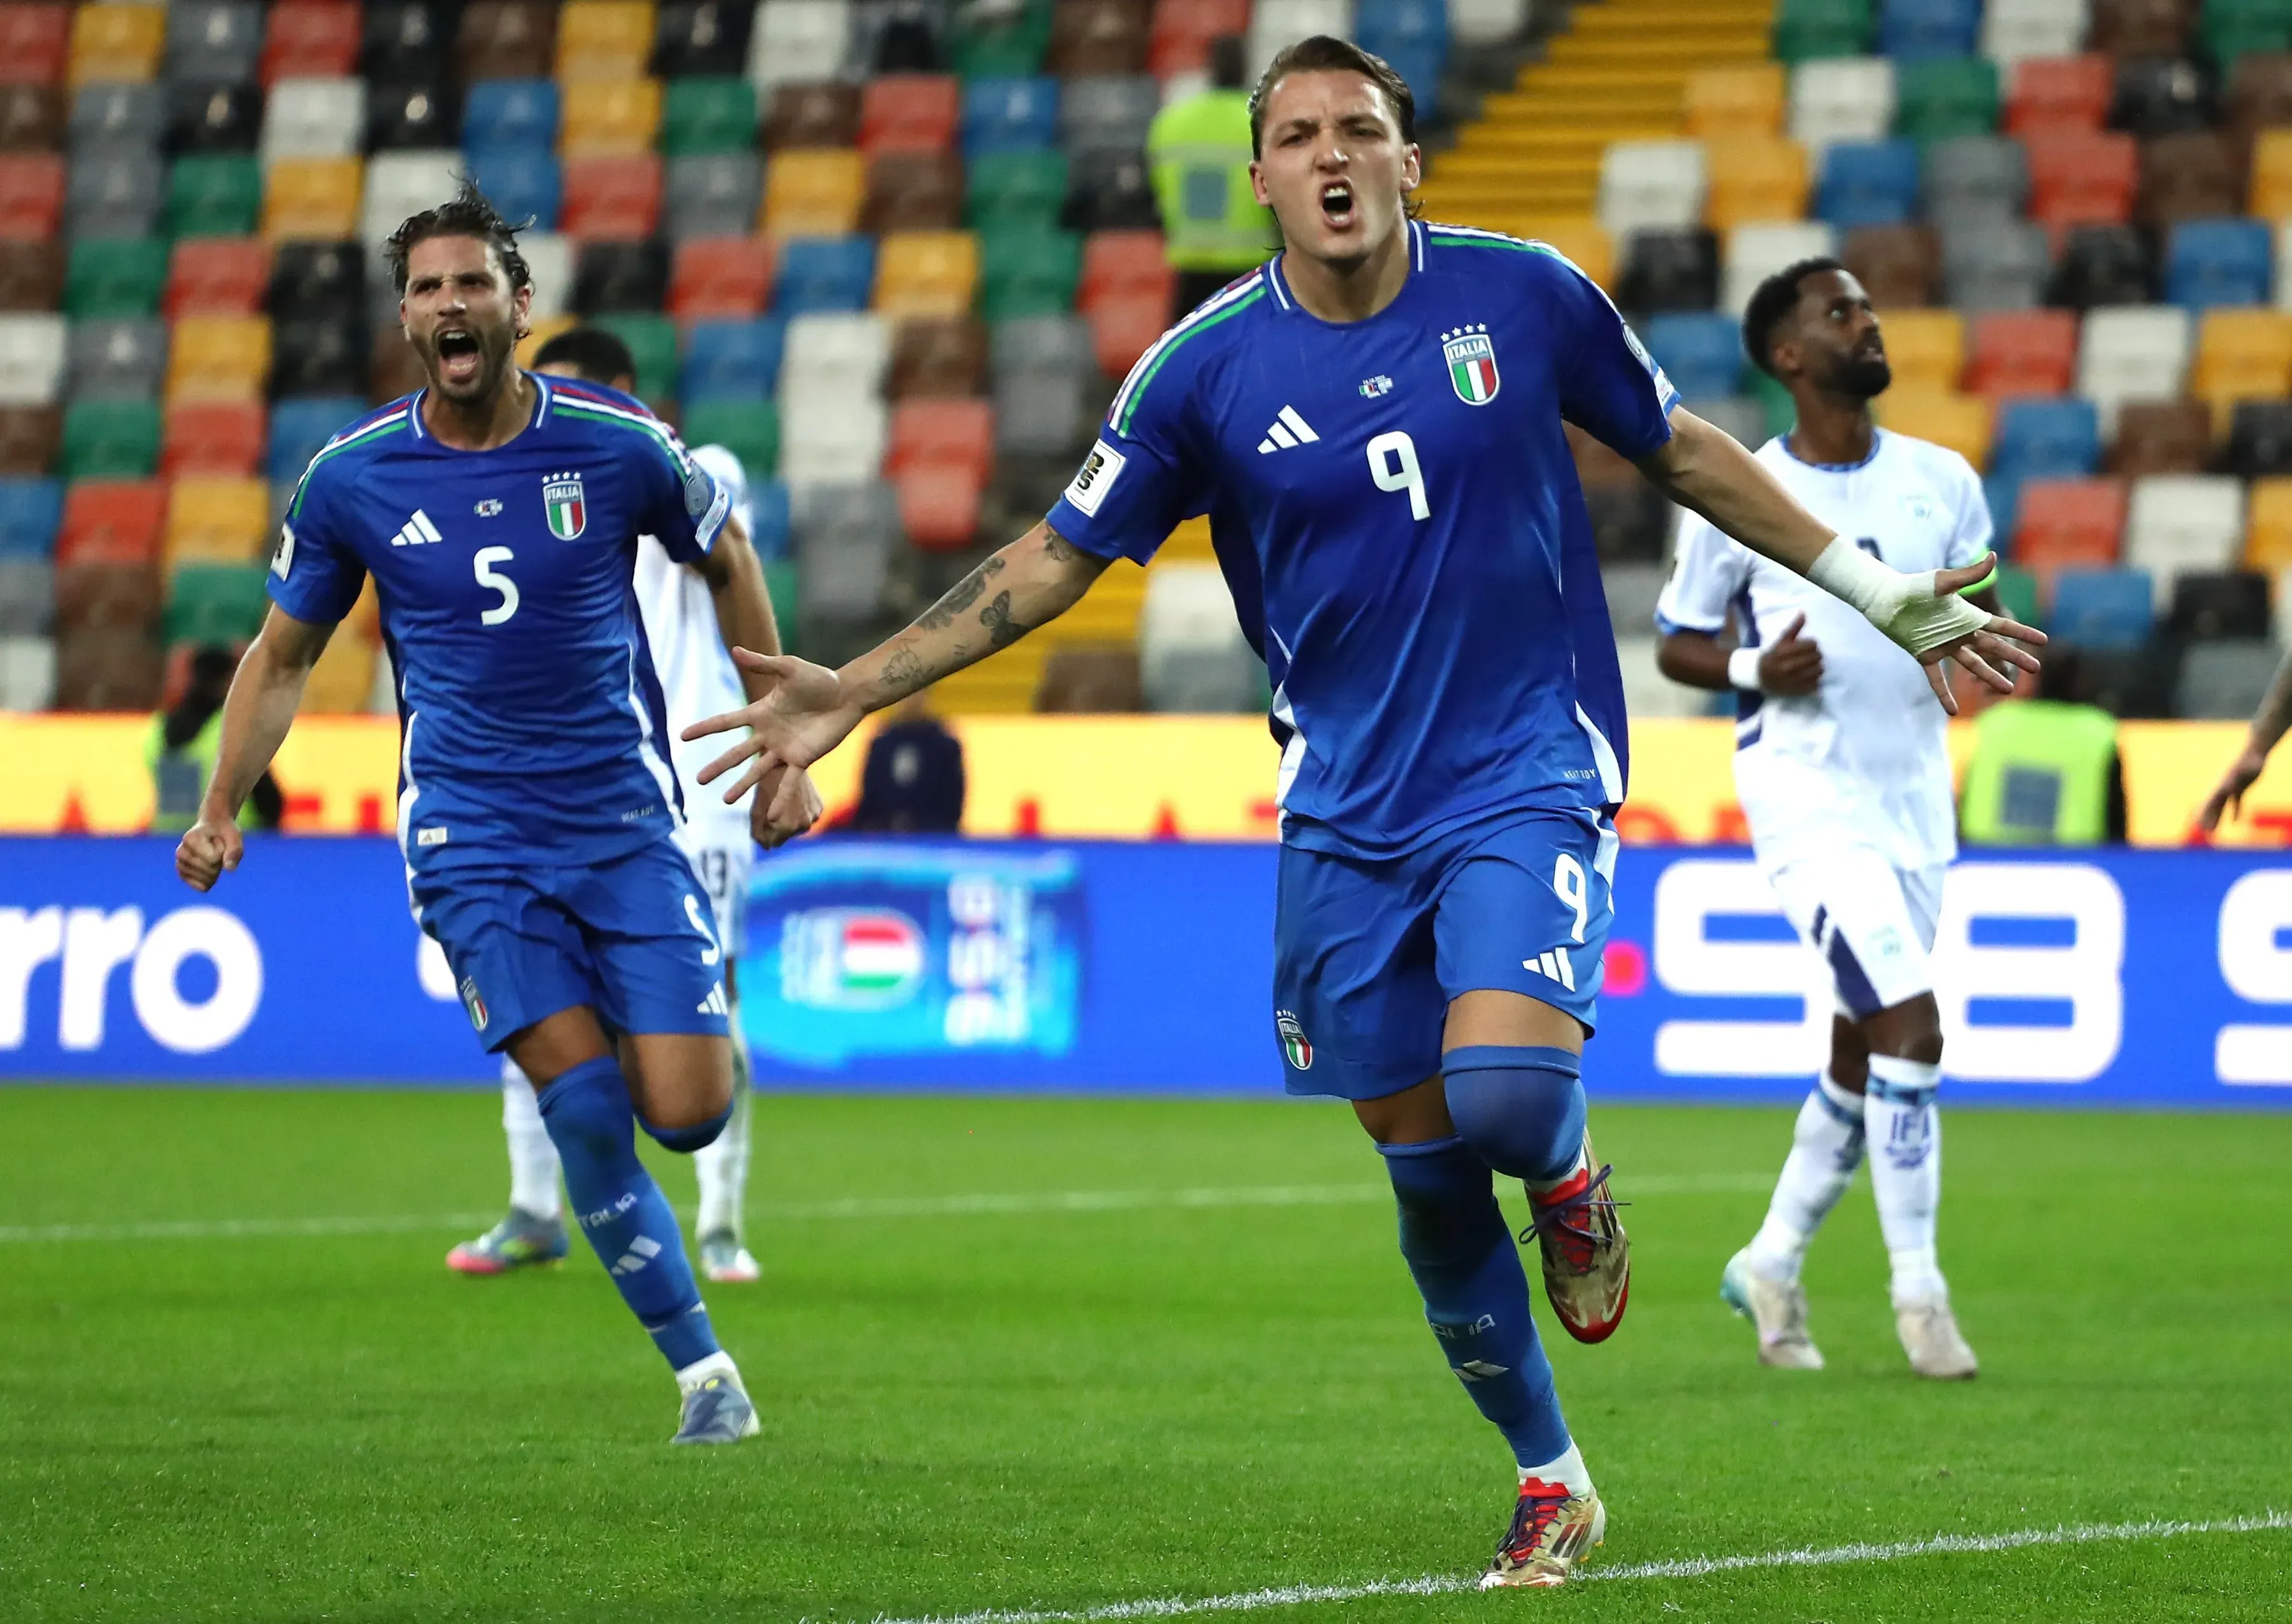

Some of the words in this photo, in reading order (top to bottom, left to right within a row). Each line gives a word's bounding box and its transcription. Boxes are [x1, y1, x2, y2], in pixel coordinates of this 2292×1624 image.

[1447, 338, 1488, 360] ITALIA
[547, 485, 580, 500] ITALIA
[1366, 431, 1430, 521] 9
[473, 545, 519, 625] 5
[1553, 853, 1587, 944] 9
